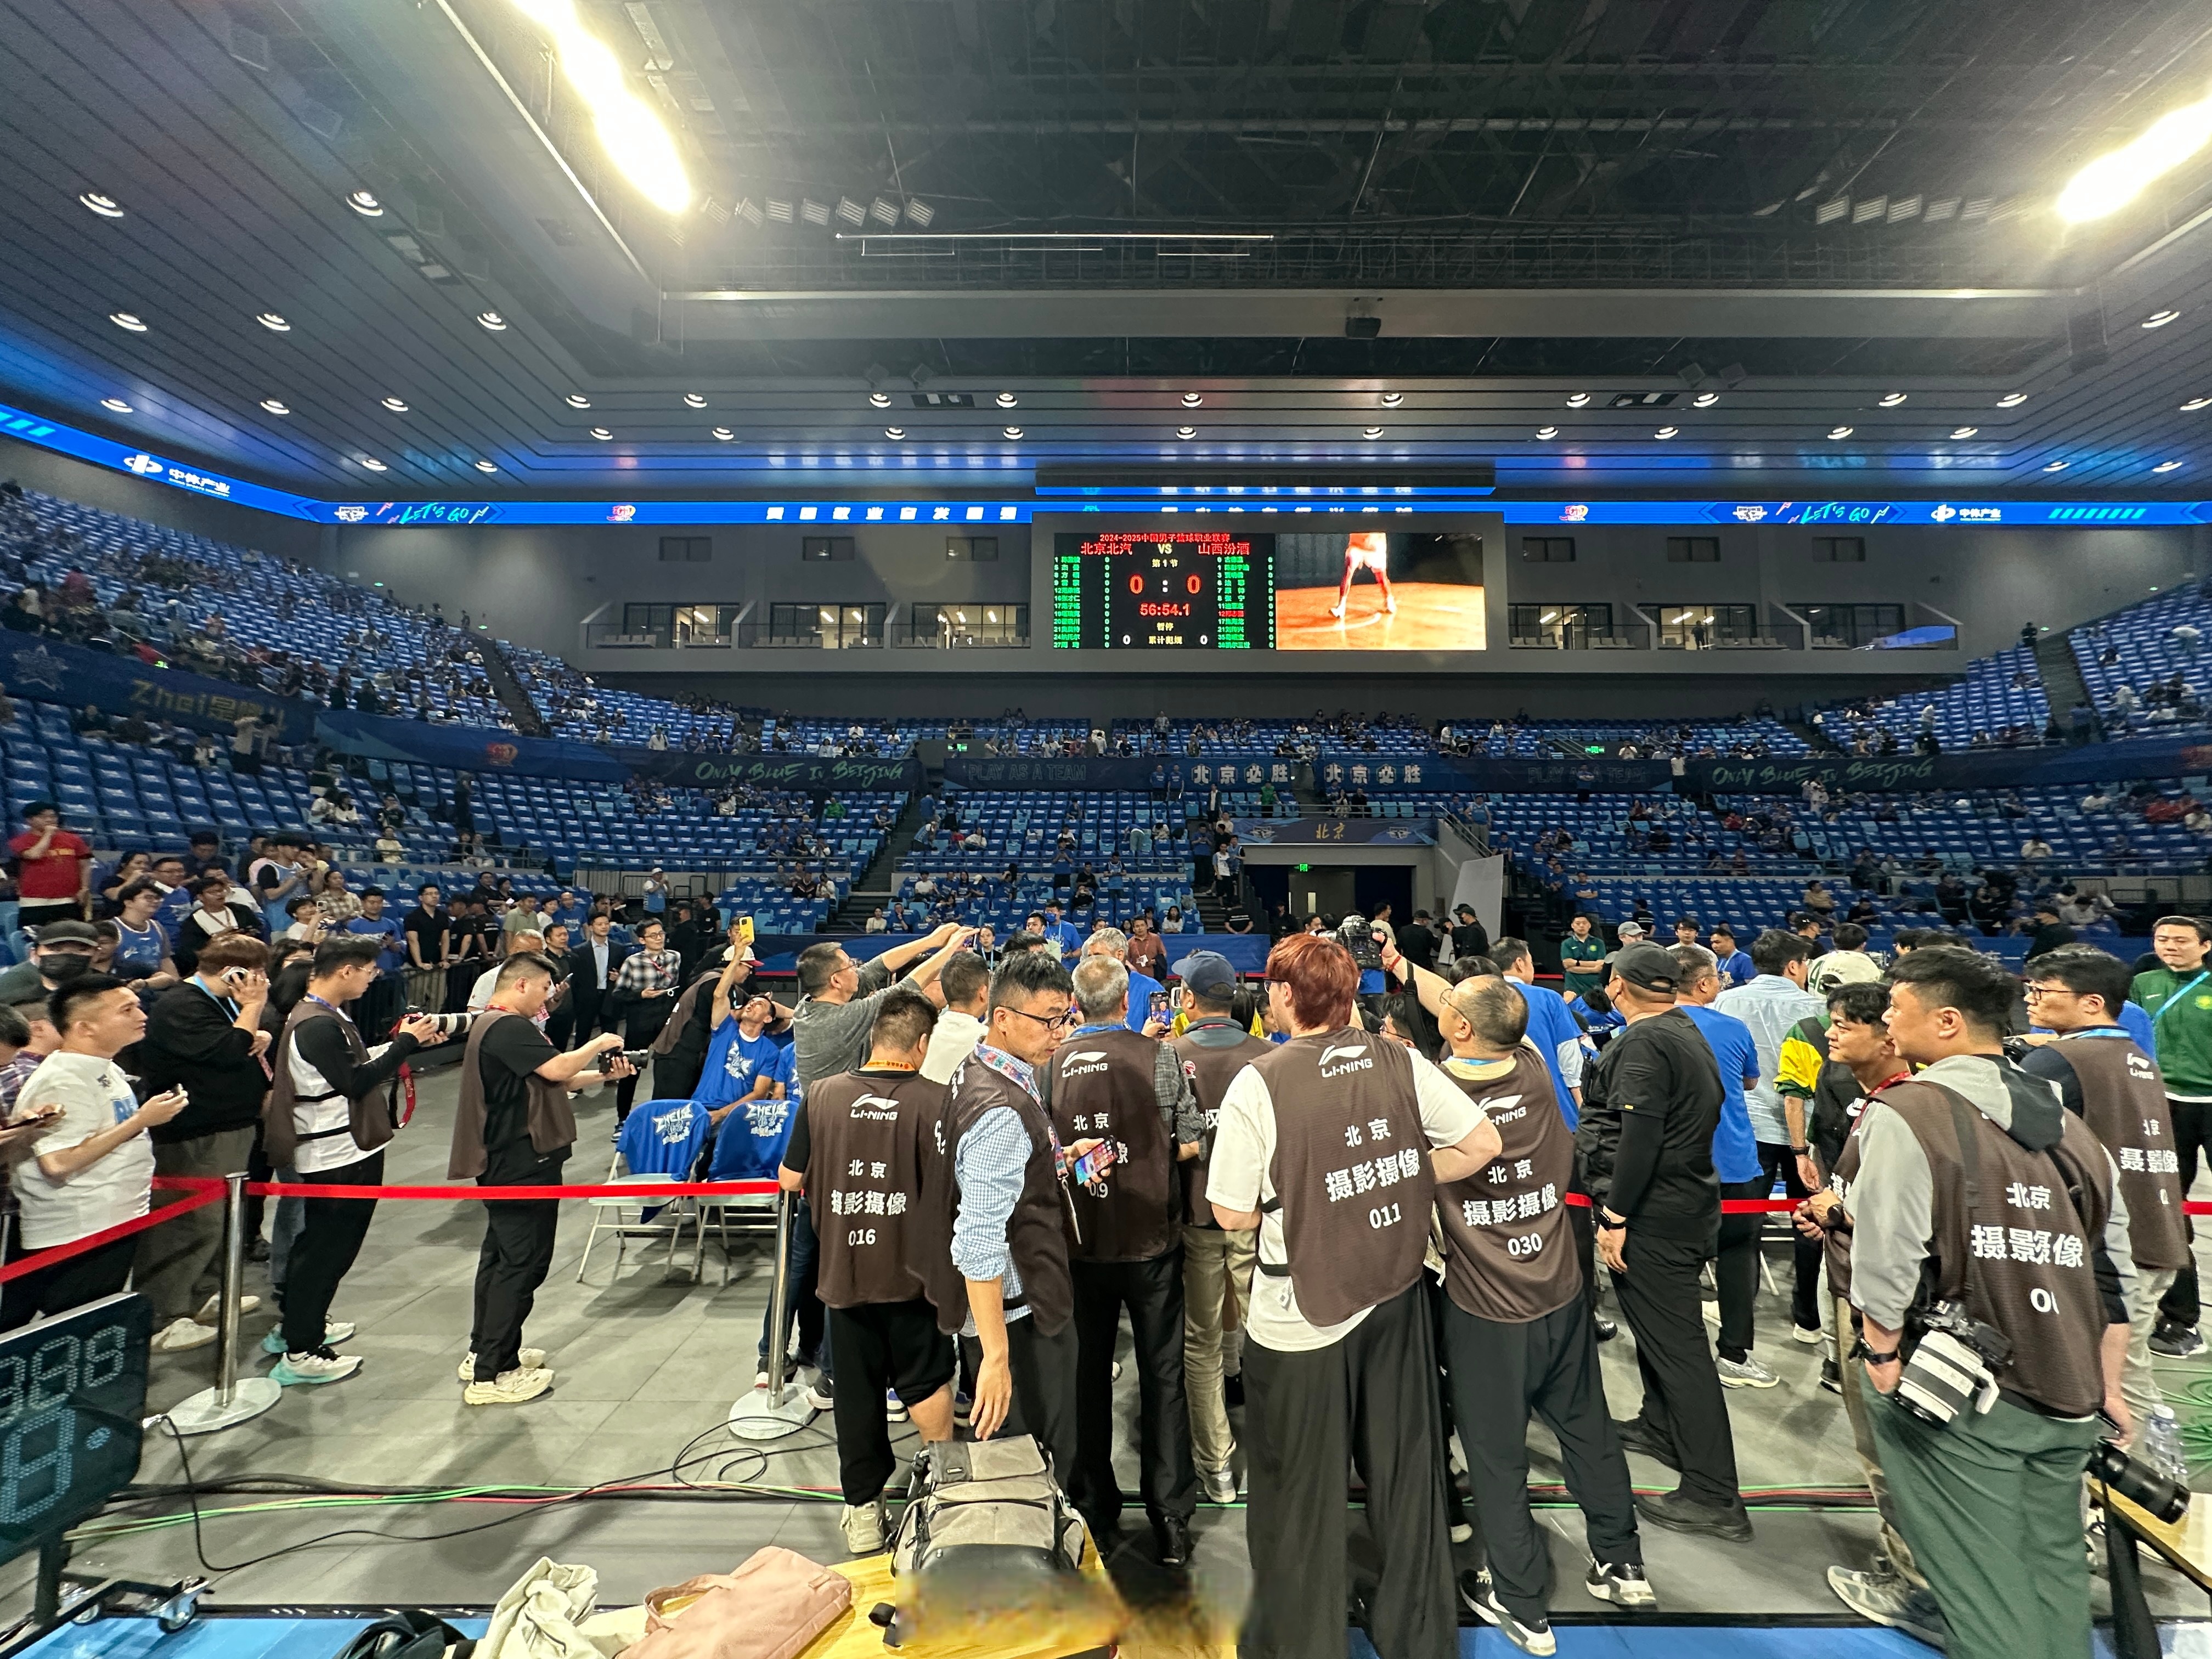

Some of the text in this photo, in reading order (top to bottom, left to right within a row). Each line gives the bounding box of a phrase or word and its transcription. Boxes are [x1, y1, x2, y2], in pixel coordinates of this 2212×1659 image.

[399, 502, 469, 524] LET'S GO
[1799, 502, 1870, 524] LET'S GO
[1081, 542, 1250, 555] 北京北汽 VS 山西汾酒
[1130, 574, 1144, 594] 0
[1187, 574, 1201, 594] 0
[1139, 603, 1190, 616] 56:54.1
[1122, 635, 1131, 645] 0
[1200, 635, 1208, 645] 0
[695, 761, 743, 780] ONLY
[748, 763, 804, 782] BLUE
[832, 760, 904, 788] BEIJING
[969, 764, 1086, 781] PLAY AS A TEAM
[1192, 764, 1288, 785] 北京必胜
[1326, 764, 1421, 784] 北京必胜
[1528, 768, 1564, 783] PLAY
[1712, 767, 1755, 786] ONLY
[1846, 758, 1934, 788] BEIJING
[1316, 822, 1345, 840] 北京
[1062, 1062, 1108, 1078] LI-NING
[1321, 1058, 1373, 1078] LI-NING
[850, 1108, 899, 1120] LI-NING
[1073, 1113, 1109, 1131] 北京
[1490, 1106, 1527, 1125] -NING
[1344, 1118, 1392, 1148] 北京
[848, 1159, 887, 1179] 北京
[2120, 1147, 2179, 1173] 摄影像
[1325, 1148, 1421, 1202] 摄影摄像
[1488, 1159, 1533, 1184] 北京
[1463, 1183, 1558, 1227] 摄影摄像
[2006, 1182, 2051, 1210] 北京
[1369, 1203, 1402, 1229] 011
[848, 1229, 876, 1246] 016
[1507, 1232, 1543, 1256] 030
